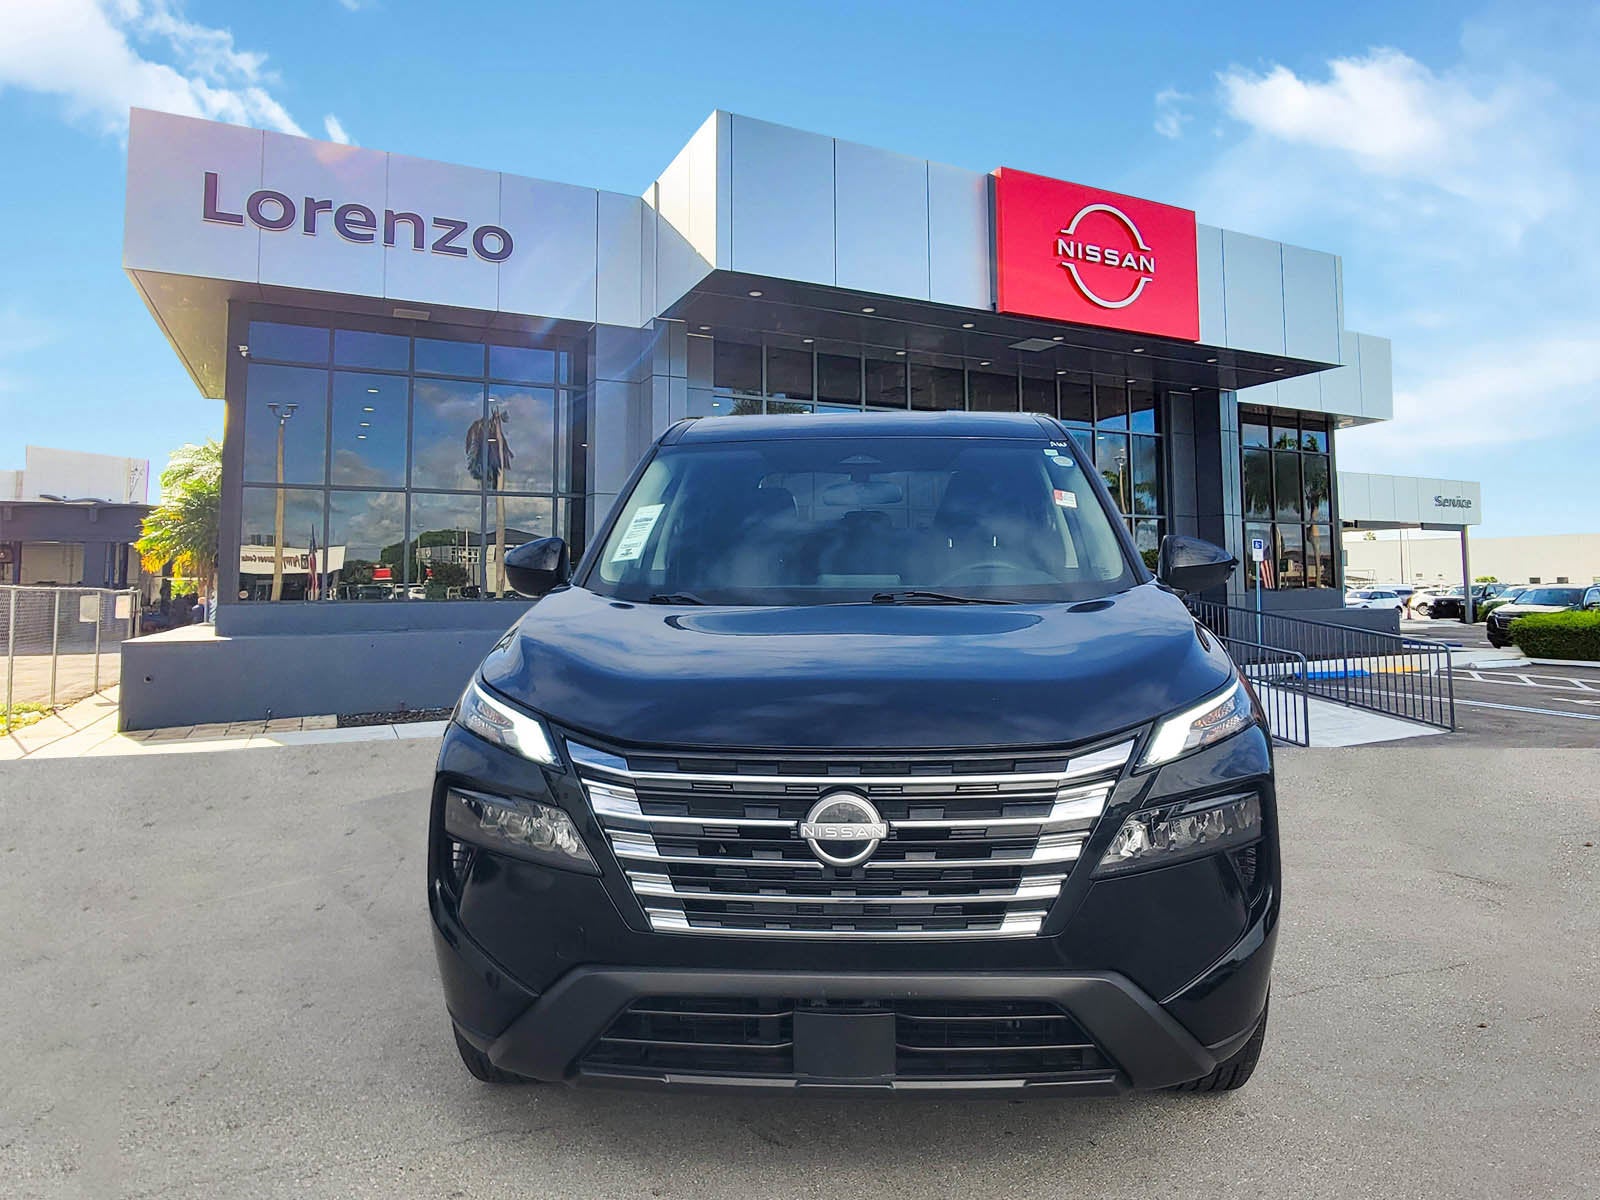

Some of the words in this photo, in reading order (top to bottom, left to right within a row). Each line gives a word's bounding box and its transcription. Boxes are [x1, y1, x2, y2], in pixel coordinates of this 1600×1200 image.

[203, 171, 514, 262] Lorenzo
[1057, 238, 1155, 273] NISSAN
[1434, 495, 1472, 509] Service
[802, 826, 884, 838] NISSAN
